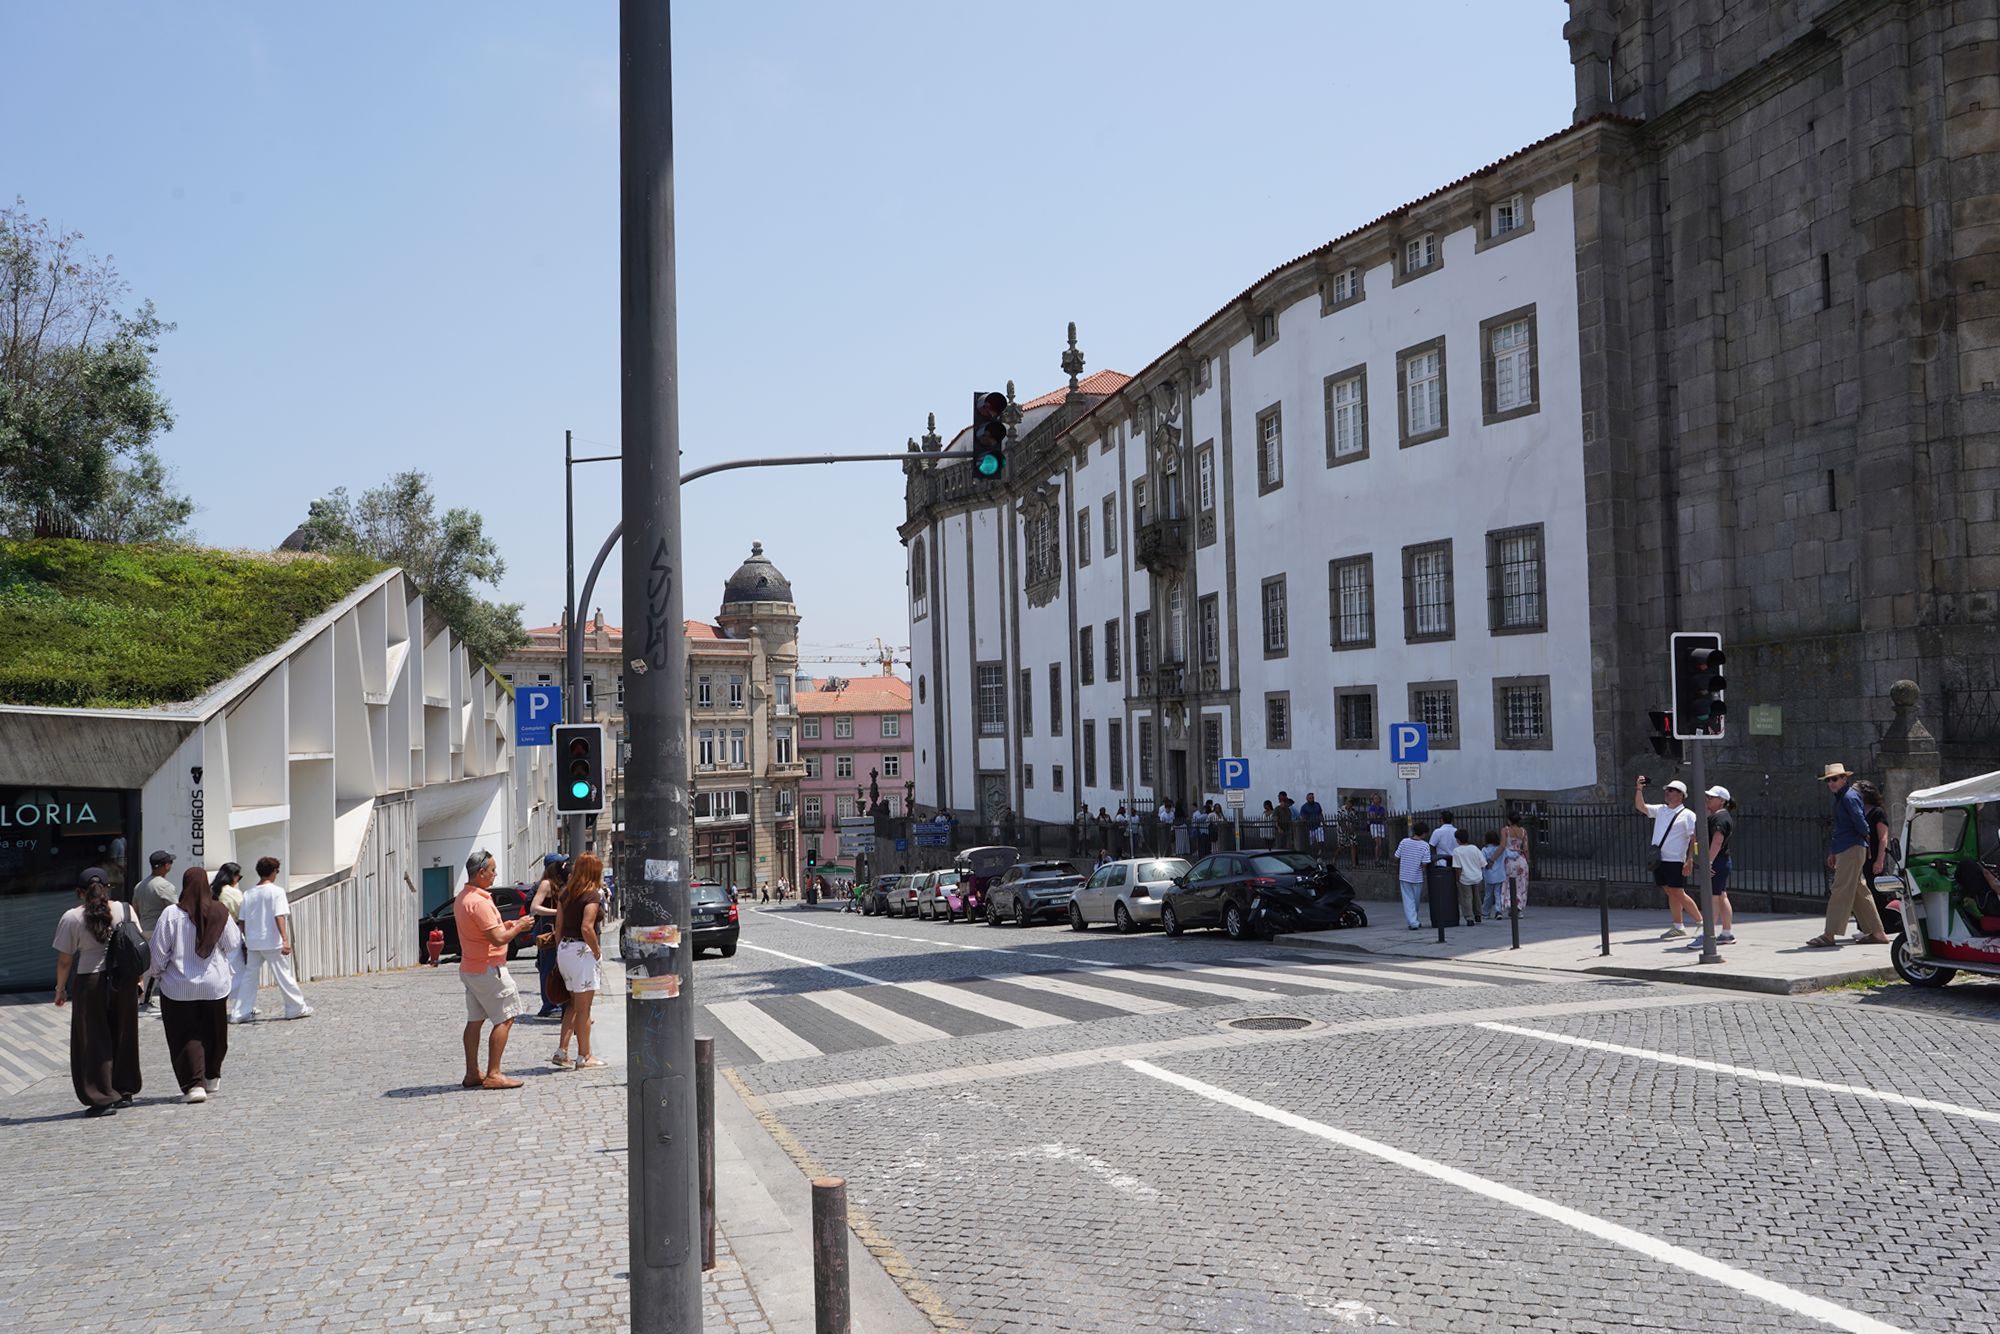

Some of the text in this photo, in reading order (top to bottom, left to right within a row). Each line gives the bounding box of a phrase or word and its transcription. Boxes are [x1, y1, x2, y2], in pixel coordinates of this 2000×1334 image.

[529, 693, 549, 719] P
[1398, 727, 1420, 759] P
[1225, 760, 1243, 786] P
[191, 789, 204, 856] CLÉRIGOS
